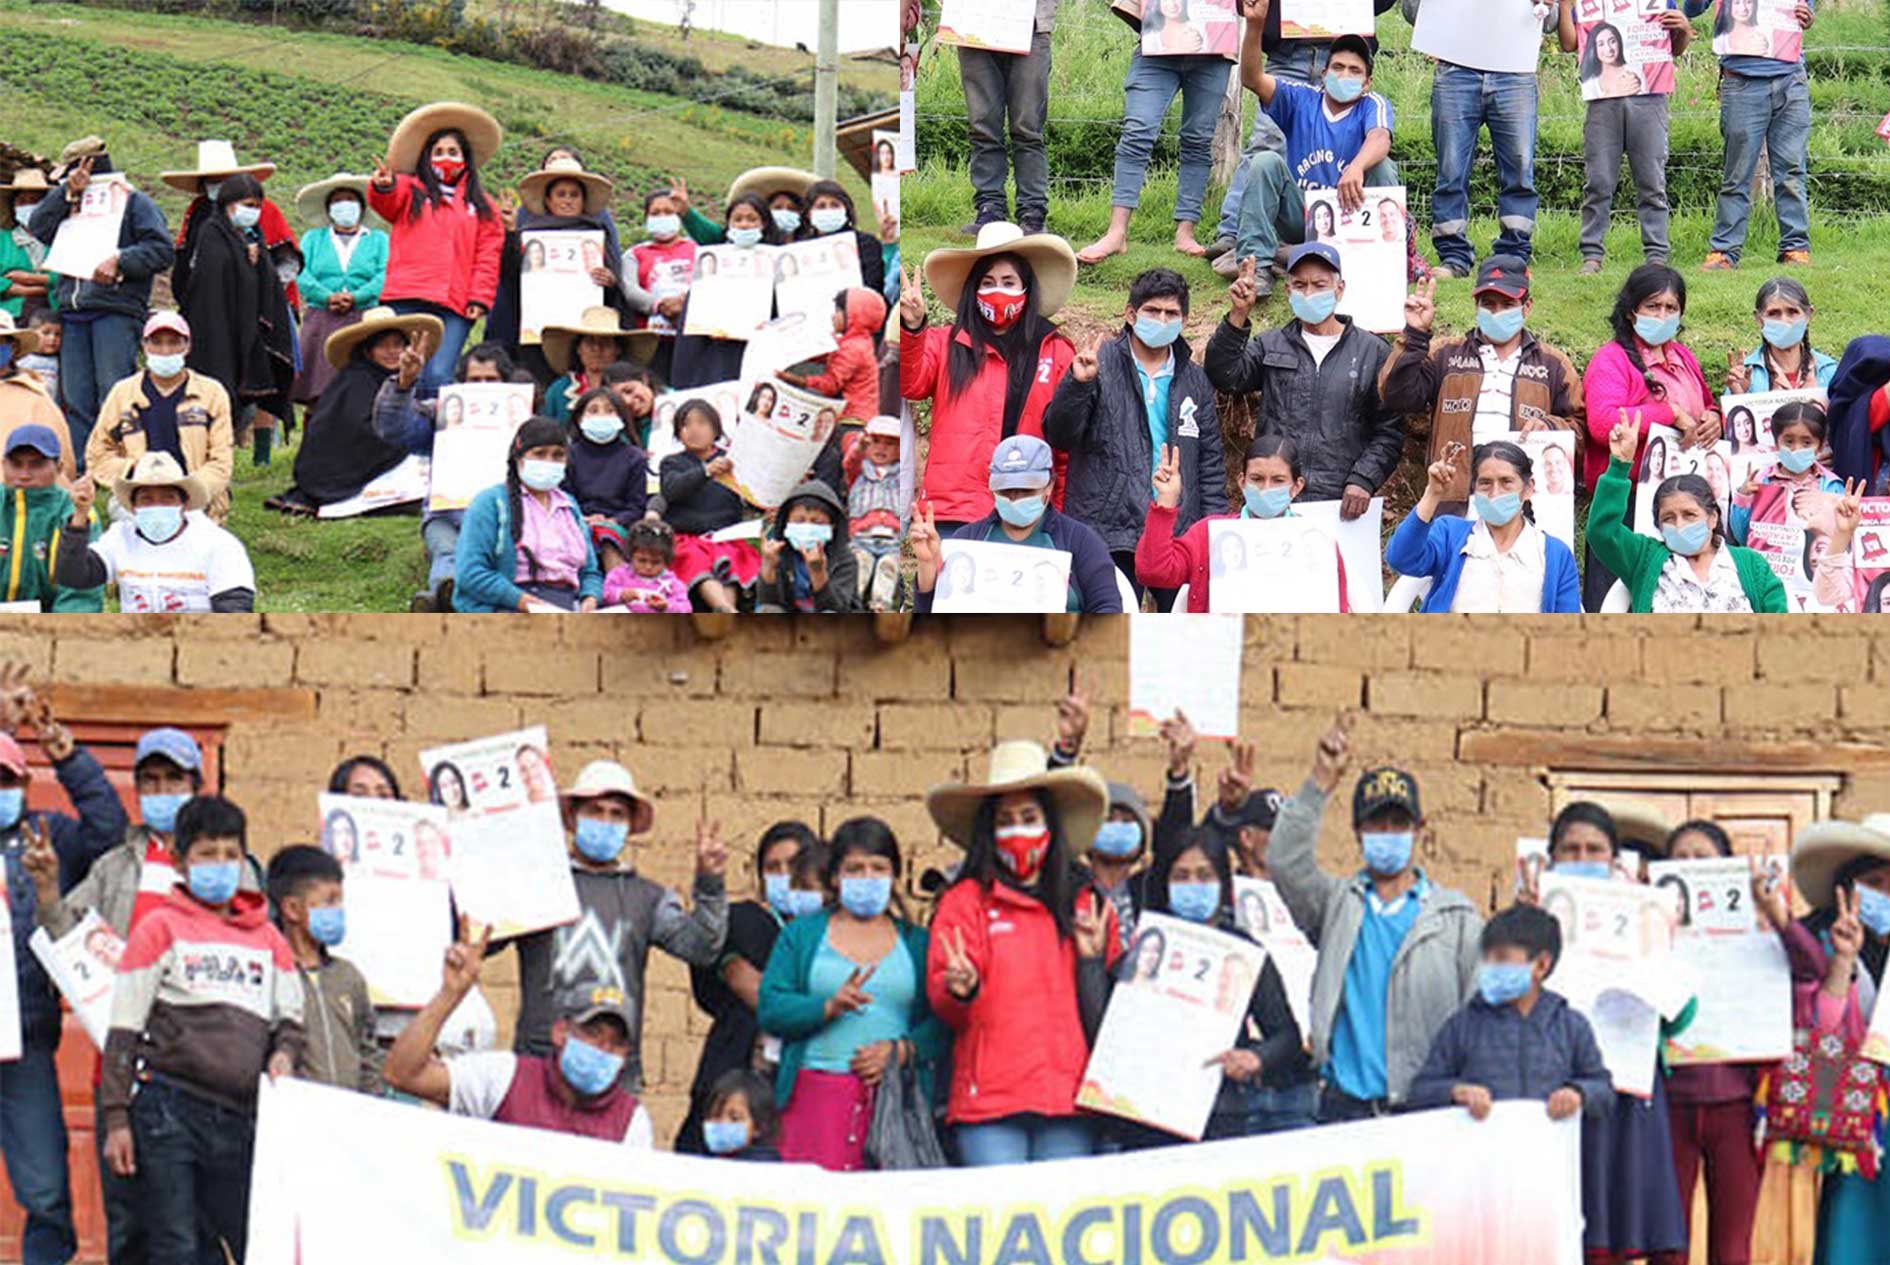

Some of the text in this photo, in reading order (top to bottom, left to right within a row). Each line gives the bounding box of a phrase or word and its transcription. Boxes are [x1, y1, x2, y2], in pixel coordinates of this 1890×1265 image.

[1362, 210, 1371, 226] 2
[567, 249, 575, 261] 2
[1038, 364, 1050, 383] 2
[490, 402, 499, 415] 2
[798, 412, 811, 428] 2
[1281, 541, 1293, 558] 2
[1011, 570, 1024, 586] 2
[497, 766, 511, 789] 2
[392, 833, 404, 856] 2
[1726, 888, 1741, 912] 2
[1614, 914, 1628, 936] 2
[74, 961, 91, 980] 2
[1193, 957, 1211, 982] 2
[447, 1160, 1419, 1265] VICTORIA NACIONAL
